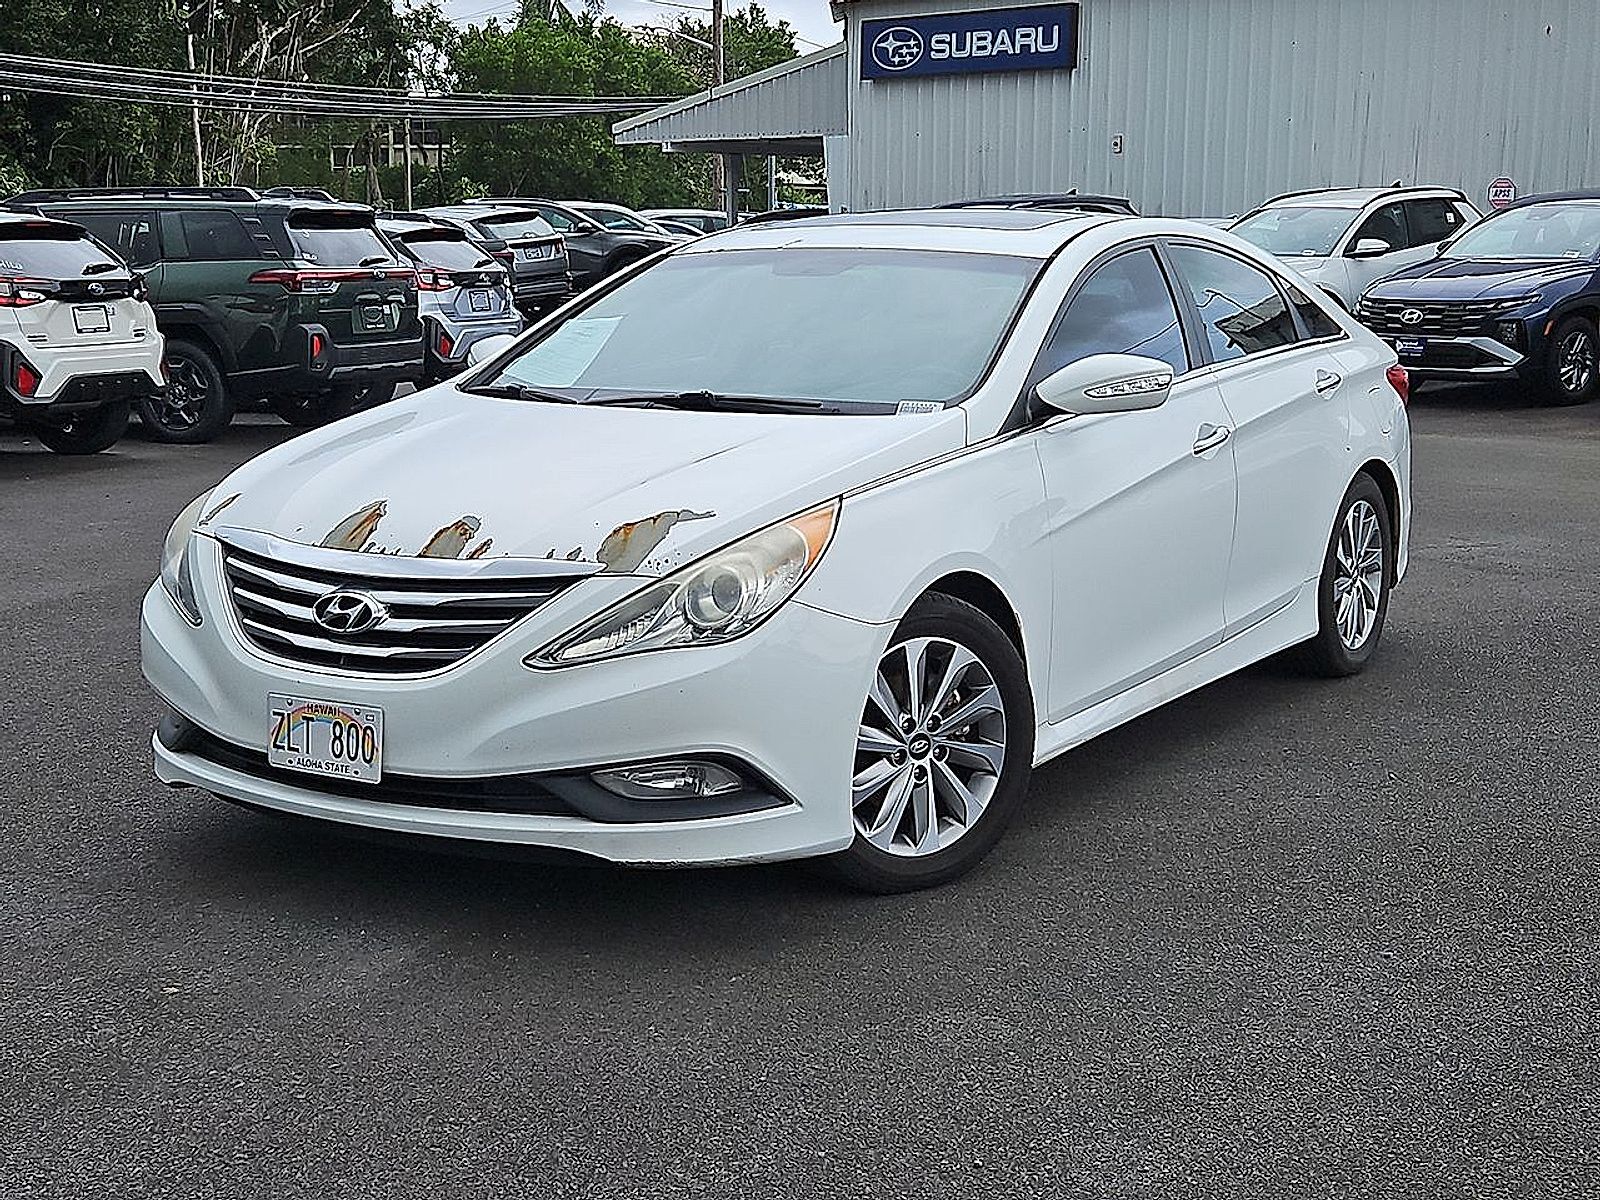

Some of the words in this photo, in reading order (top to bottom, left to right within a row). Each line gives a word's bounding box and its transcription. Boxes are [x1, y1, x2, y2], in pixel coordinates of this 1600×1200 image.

[930, 25, 1059, 59] SUBARU
[306, 703, 341, 717] HAWAII
[272, 710, 315, 755] ZLT
[331, 720, 375, 764] 800
[296, 757, 323, 770] ALOHA
[324, 761, 351, 774] STATE
